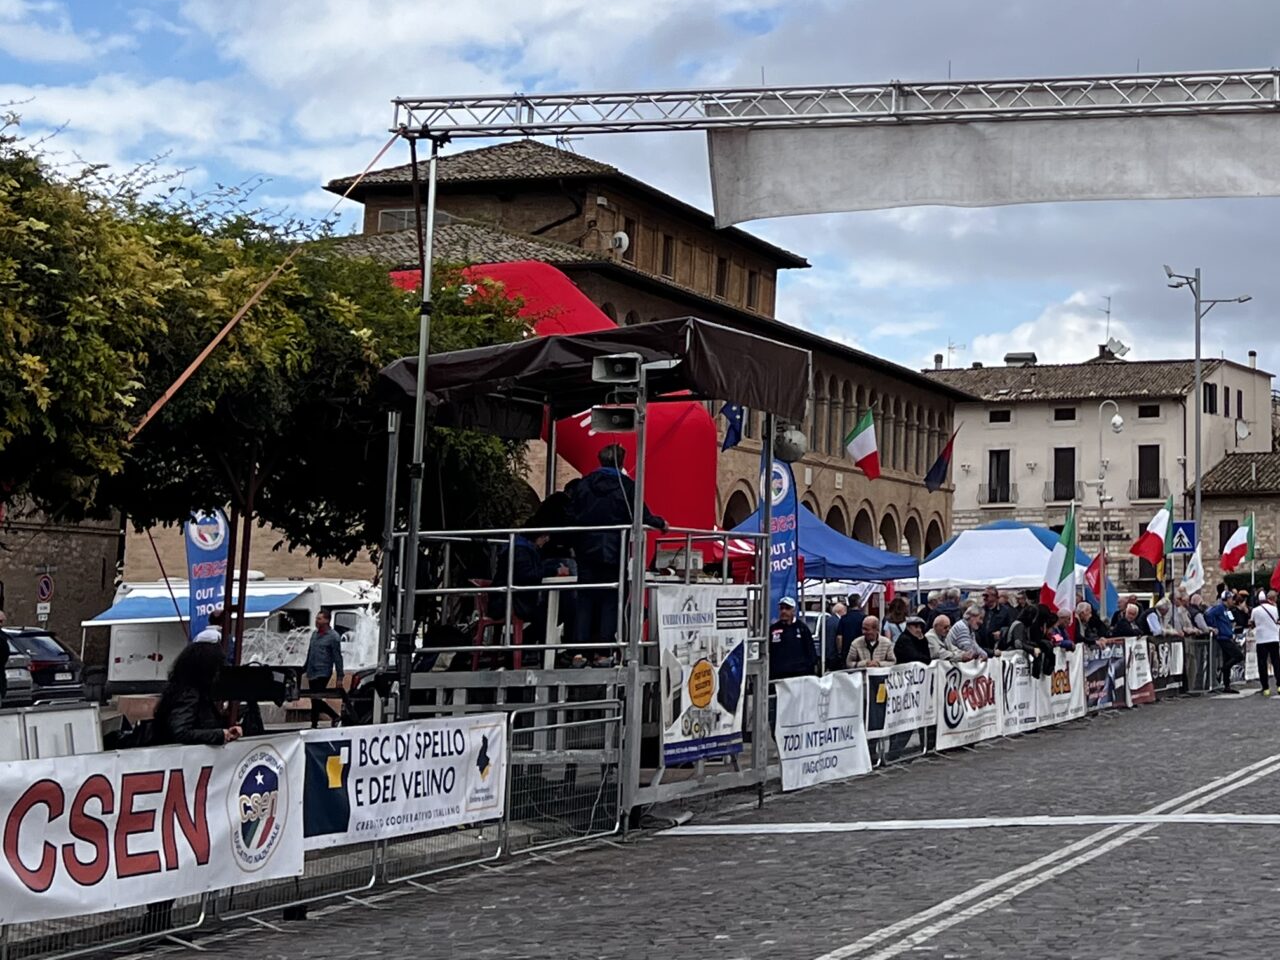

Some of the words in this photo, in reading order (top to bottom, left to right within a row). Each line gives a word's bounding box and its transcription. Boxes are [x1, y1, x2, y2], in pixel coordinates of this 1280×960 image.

[1087, 521, 1124, 531] HOTEL
[359, 735, 391, 767] BCC
[395, 733, 410, 763] DI
[415, 728, 465, 760] SPELLO
[355, 778, 364, 807] E
[369, 774, 396, 805] DEL
[401, 766, 456, 799] VELINO
[3, 765, 213, 893] CSEN
[355, 819, 384, 832] CREDITO
[385, 809, 432, 826] COOPERATIVO
[433, 806, 460, 818] ITALIANO
